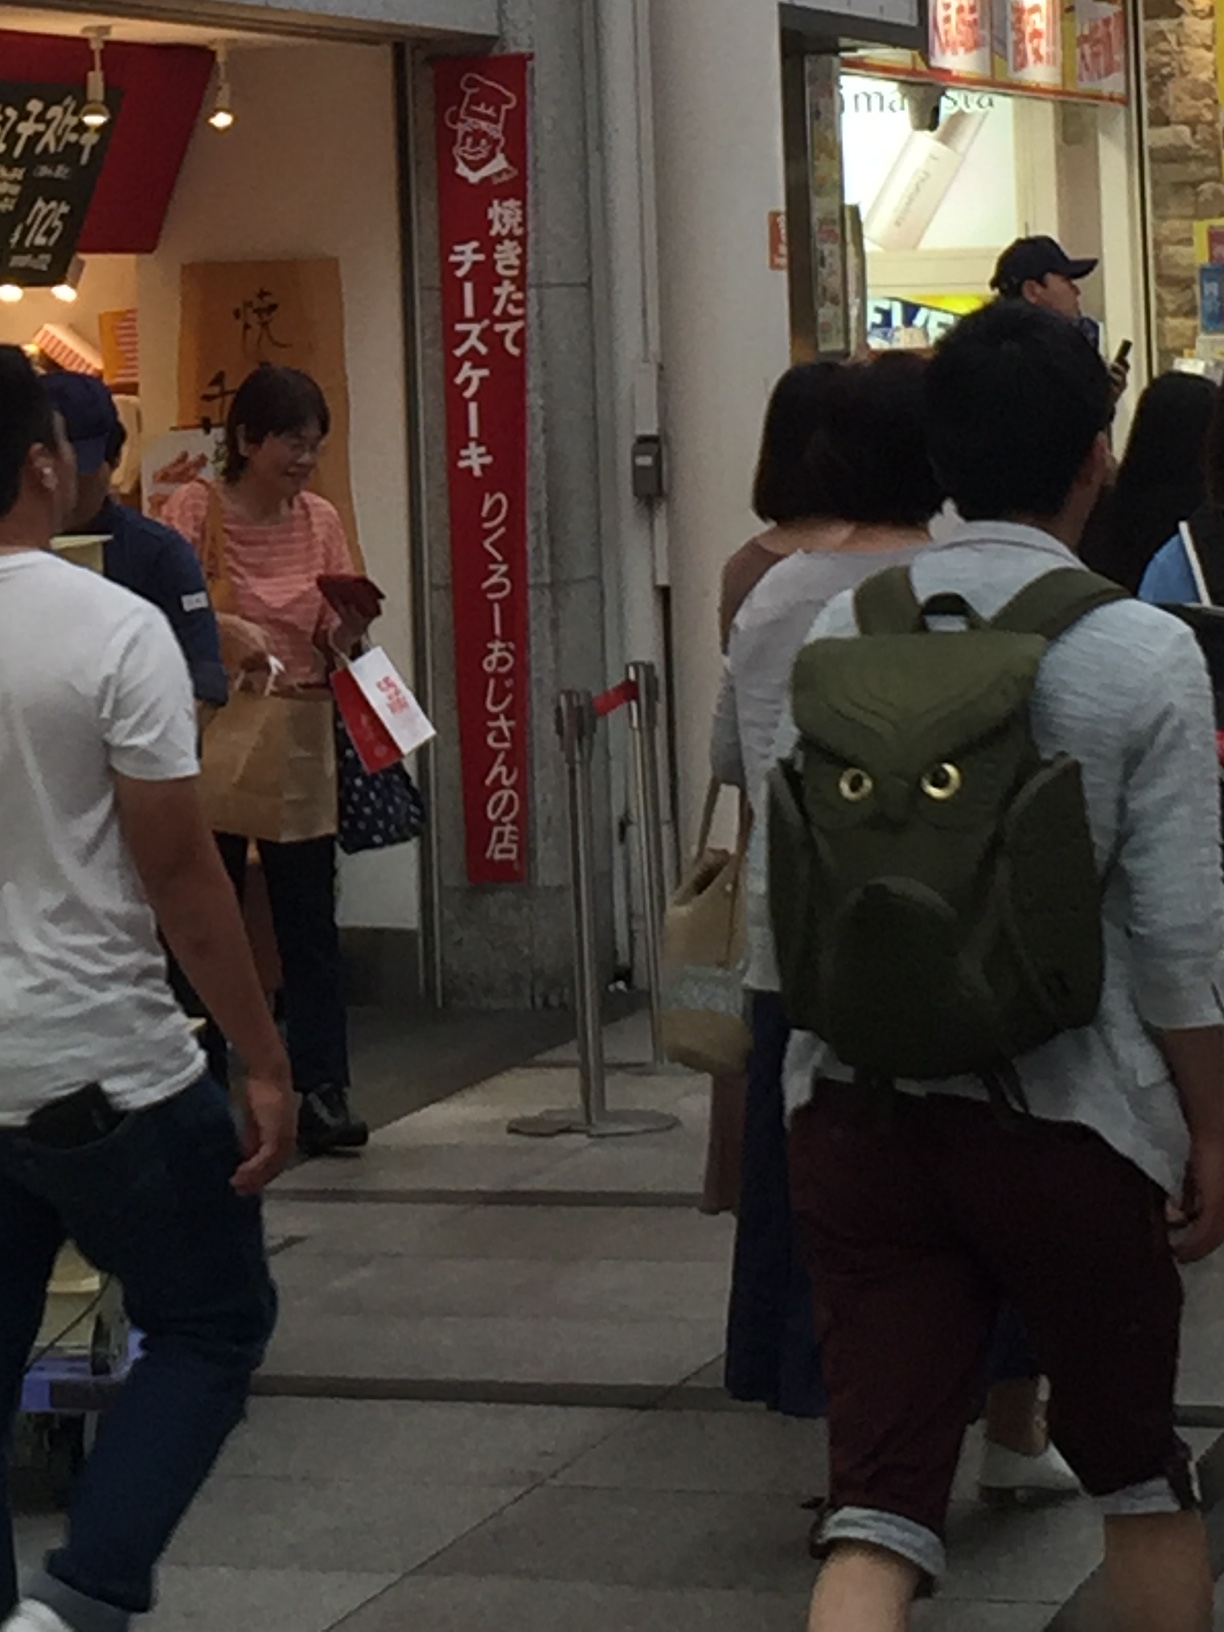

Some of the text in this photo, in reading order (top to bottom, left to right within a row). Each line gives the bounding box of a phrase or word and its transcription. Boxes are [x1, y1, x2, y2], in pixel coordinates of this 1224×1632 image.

[447, 240, 494, 478] チーズケーキ
[487, 198, 526, 358] 焼きたて
[480, 491, 521, 862] りくろーおじさんの店
